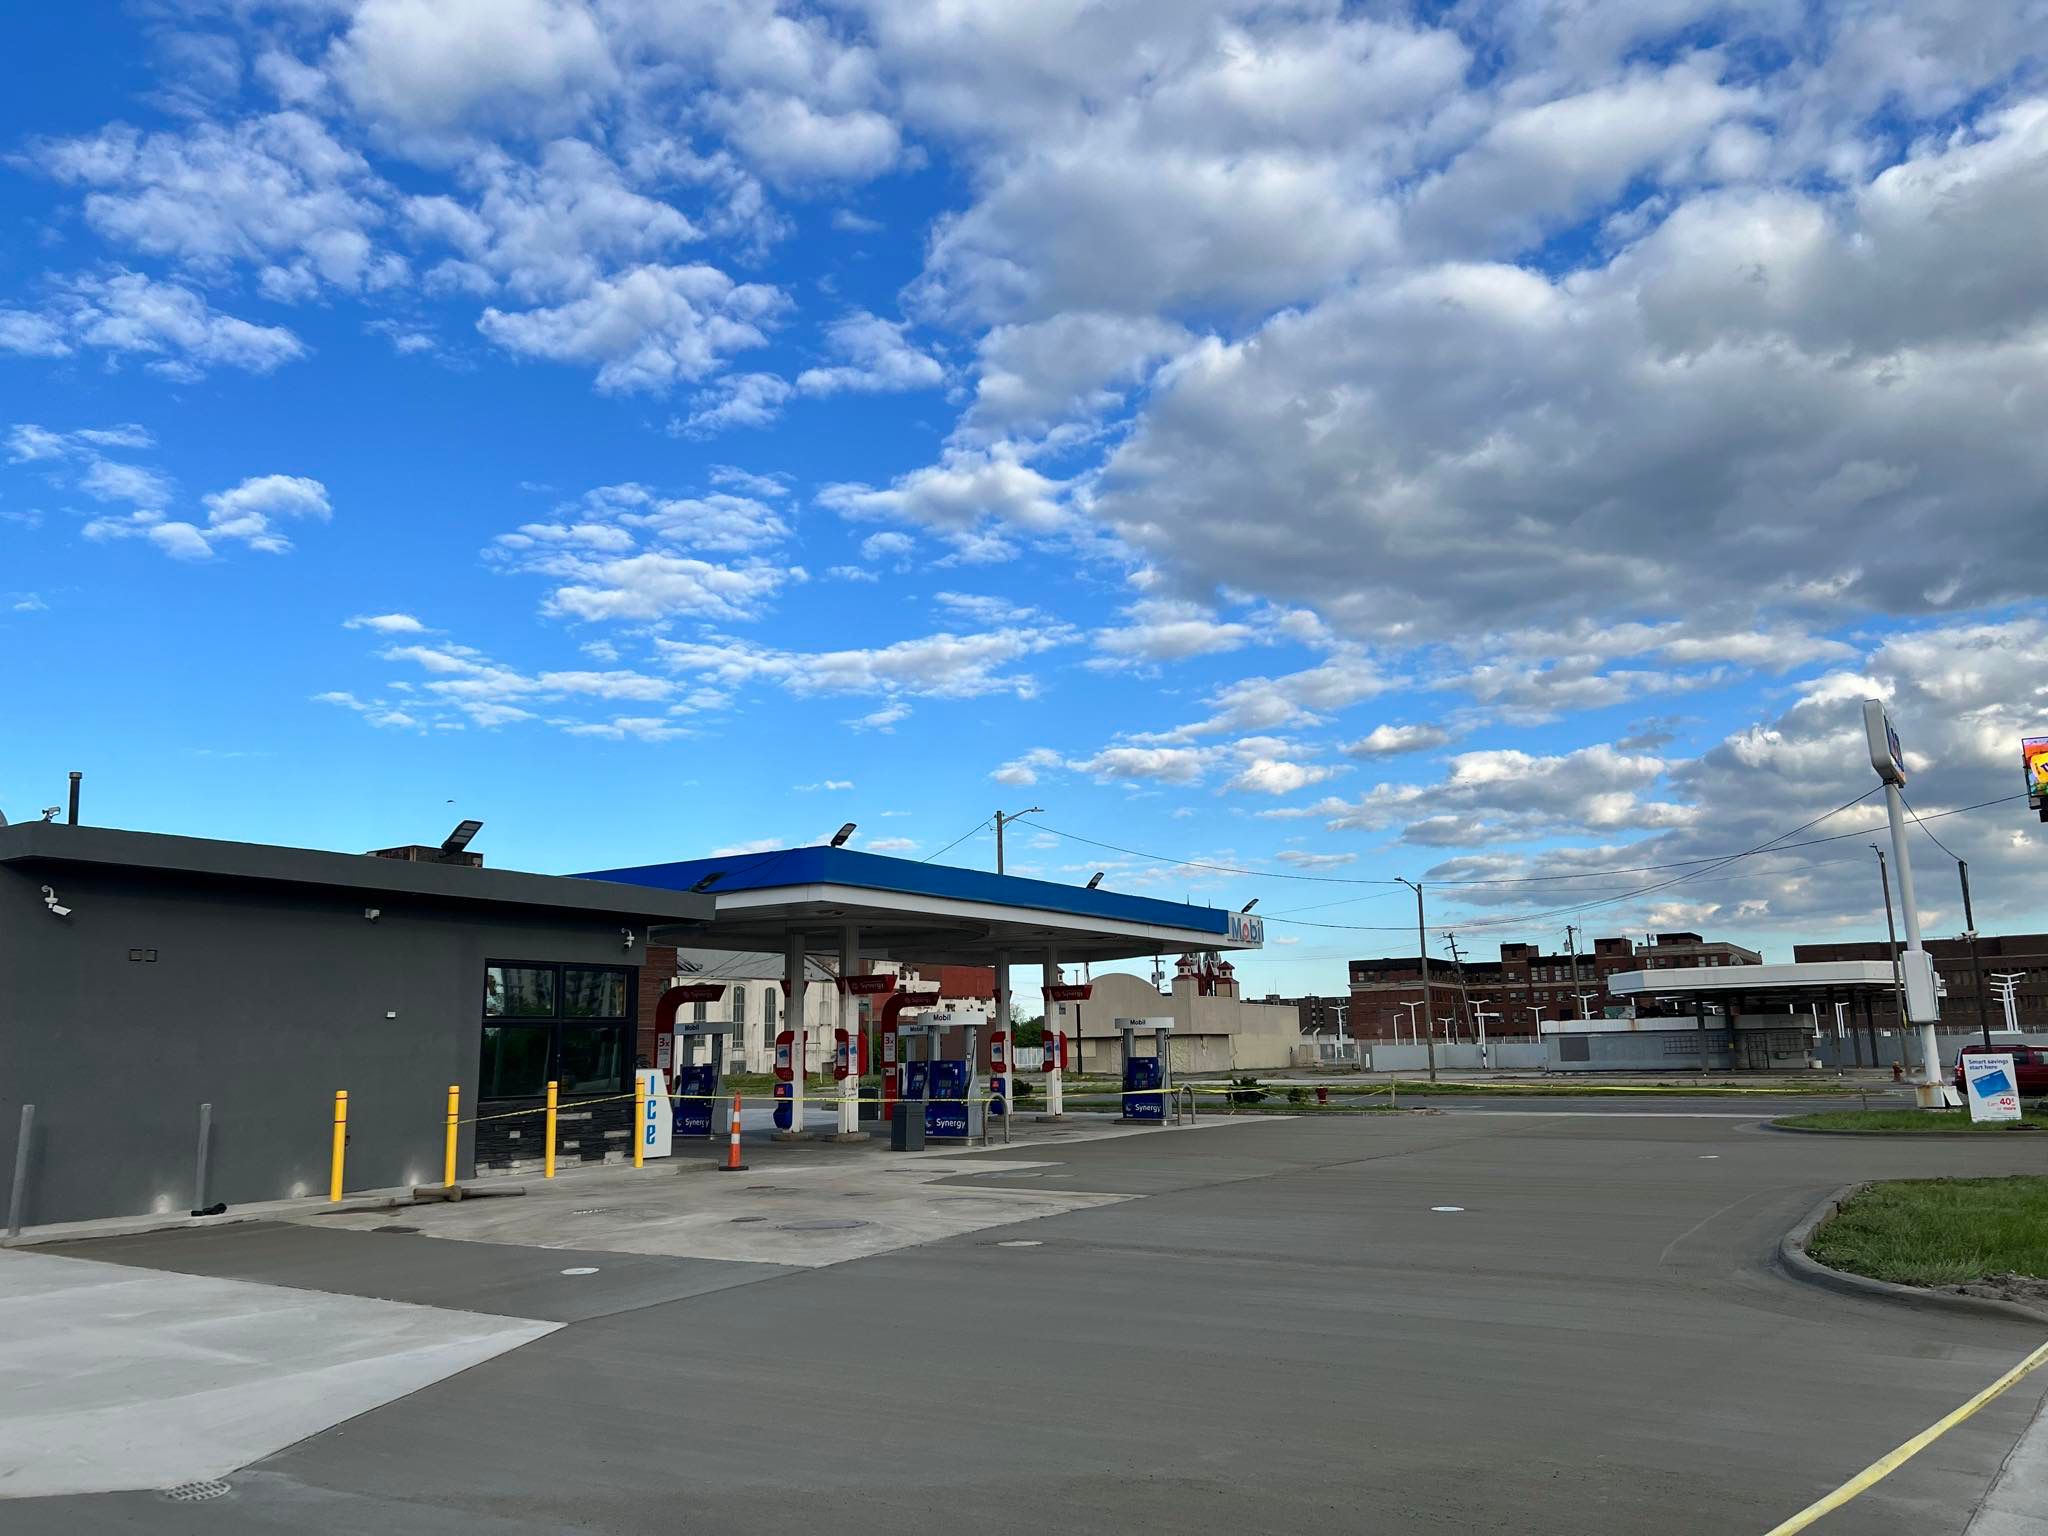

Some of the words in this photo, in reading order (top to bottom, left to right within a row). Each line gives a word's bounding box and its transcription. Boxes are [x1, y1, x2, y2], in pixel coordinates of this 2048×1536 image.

[1231, 917, 1264, 942] Mobil
[933, 1013, 951, 1021] Mobil
[658, 1037, 670, 1047] 3x
[885, 1036, 894, 1045] 3x
[1135, 1103, 1161, 1113] Synergy
[685, 1117, 710, 1129] Synergy
[936, 1117, 966, 1129] Synergy
